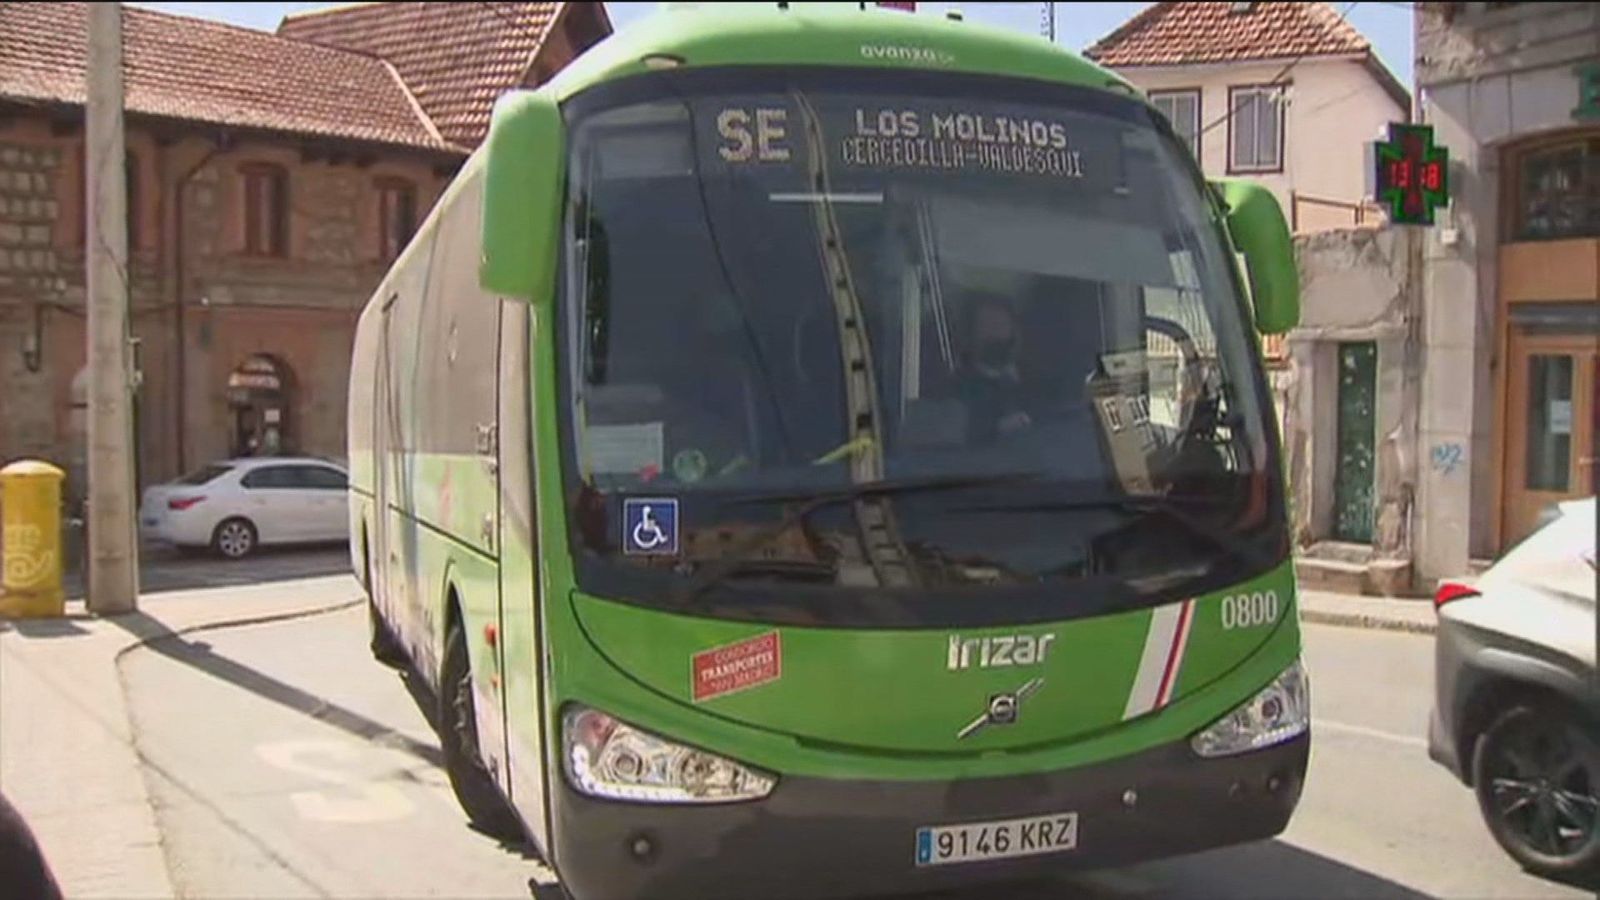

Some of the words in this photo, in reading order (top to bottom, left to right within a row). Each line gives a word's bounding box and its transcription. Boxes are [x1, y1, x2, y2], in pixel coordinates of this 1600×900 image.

[860, 45, 937, 62] avanza
[717, 109, 791, 161] SE
[855, 109, 920, 137] LOS
[931, 112, 1067, 149] MOLINOS
[1221, 590, 1278, 630] 0800
[947, 634, 1056, 670] Irizar
[937, 826, 1011, 858] 9146
[1020, 818, 1071, 850] KRZ
